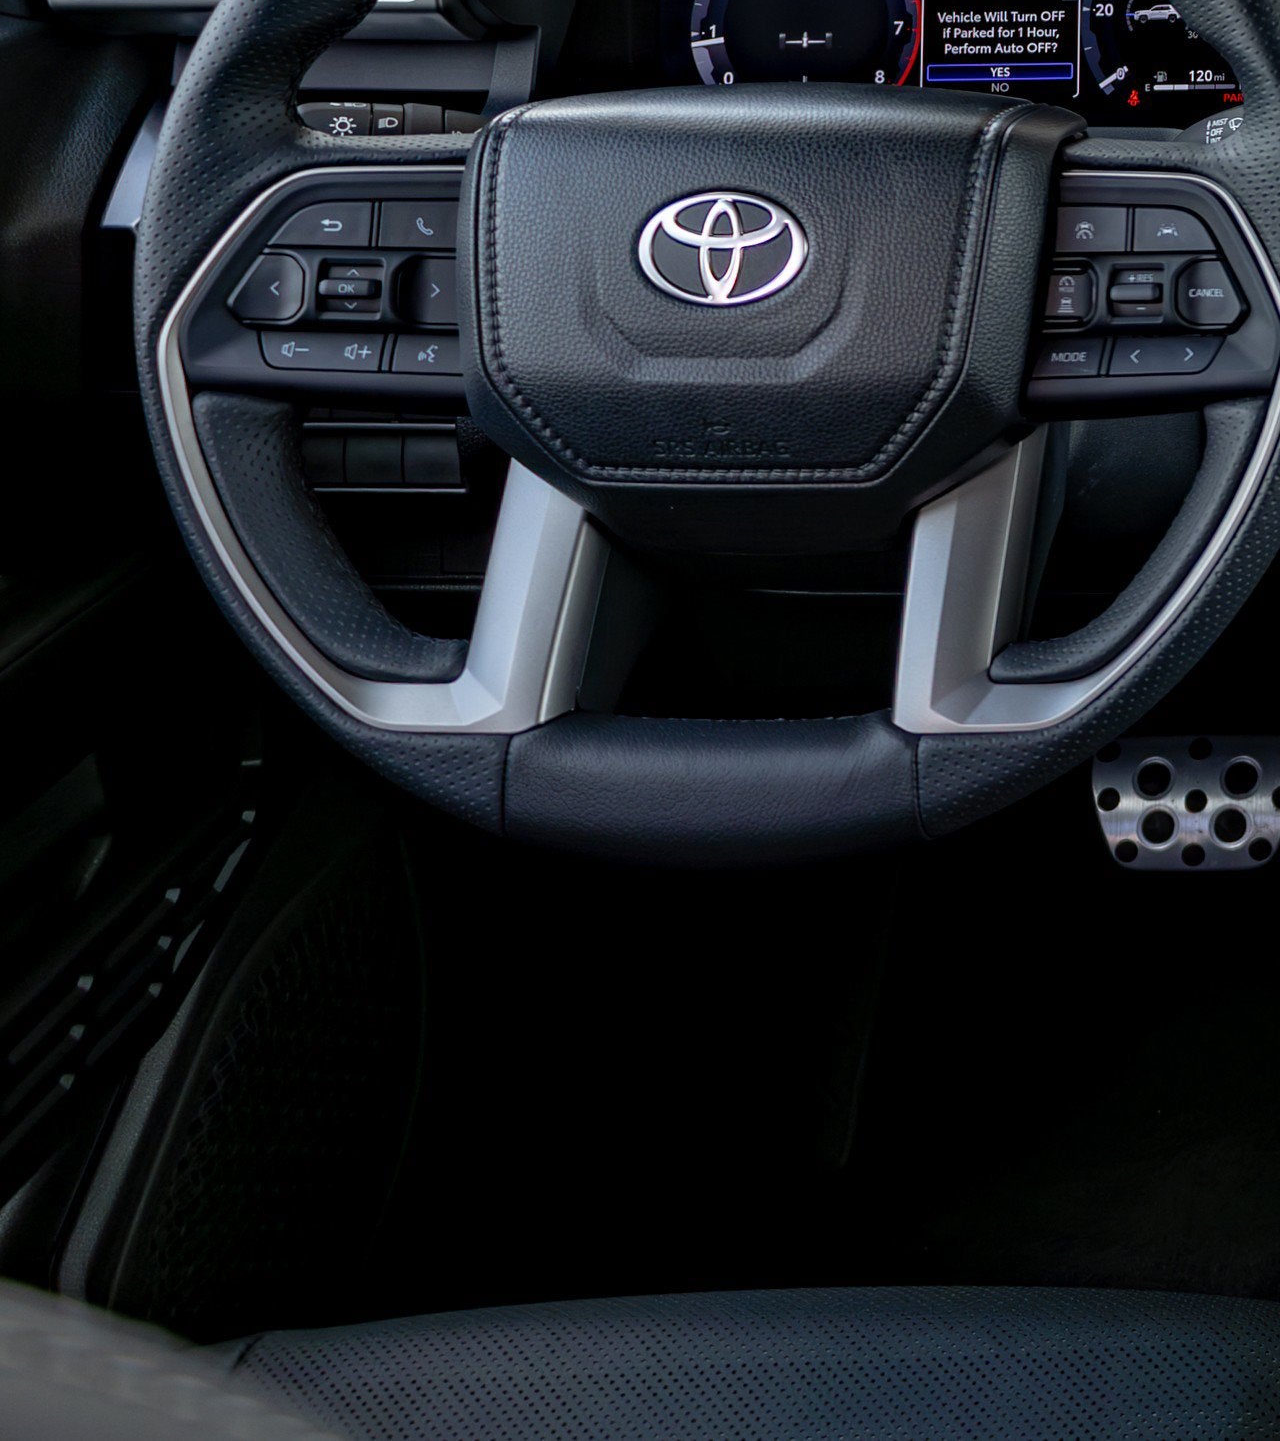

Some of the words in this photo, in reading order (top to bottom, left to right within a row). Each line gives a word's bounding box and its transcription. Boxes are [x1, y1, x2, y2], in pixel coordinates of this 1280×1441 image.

[1095, 4, 1114, 16] 20
[938, 12, 981, 23] Vehicle
[984, 11, 1008, 22] Will
[1011, 12, 1038, 22] Turn
[1040, 11, 1066, 22] OFF
[894, 21, 904, 35] 7
[942, 28, 952, 38] if
[953, 28, 995, 38] Parked
[998, 27, 1014, 37] for
[1018, 28, 1023, 37] 1
[1027, 27, 1060, 39] Hour,
[944, 43, 991, 55] Perform
[994, 43, 1024, 54] Auto
[1027, 42, 1058, 53] OFF?
[875, 71, 885, 84] 8
[990, 67, 1011, 77] YES
[1188, 70, 1212, 82] 120
[1214, 73, 1225, 81] mi
[991, 83, 1009, 93] NO
[338, 283, 355, 293] OK
[1188, 288, 1224, 297] CANCEL
[1051, 352, 1087, 362] MODE
